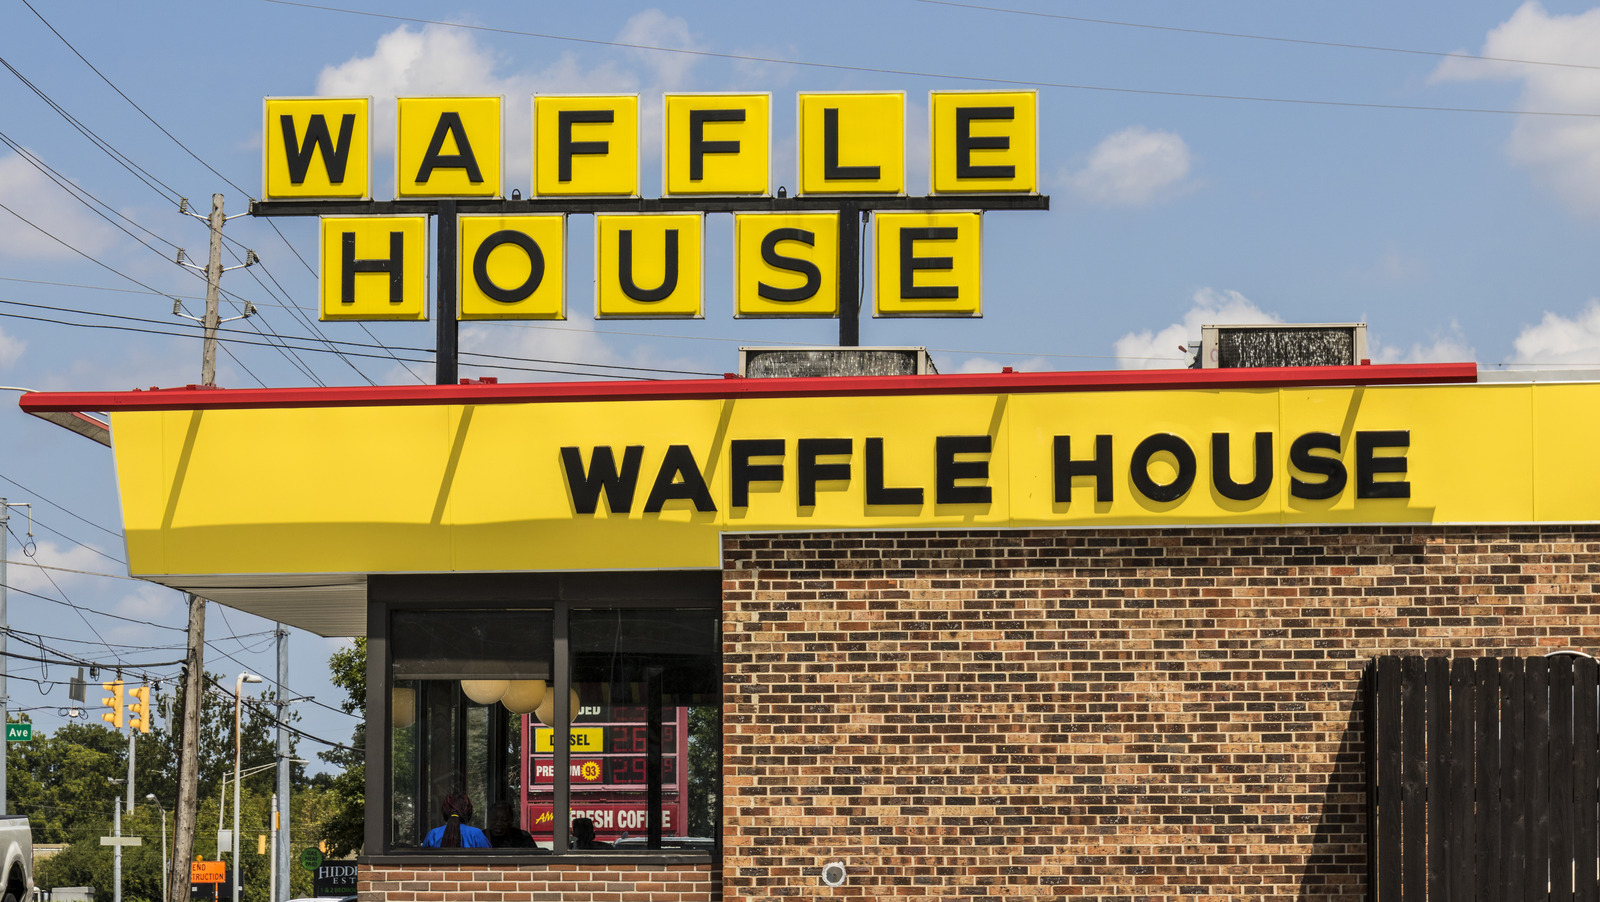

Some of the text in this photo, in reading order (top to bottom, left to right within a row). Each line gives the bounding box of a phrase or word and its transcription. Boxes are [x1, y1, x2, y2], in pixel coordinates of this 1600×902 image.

[281, 107, 1015, 184] WAFFLE
[341, 227, 959, 304] HOUSE
[560, 430, 1411, 515] WAFFLE HOUSE
[9, 727, 29, 737] Ave
[549, 734, 591, 746] DSEL
[536, 765, 581, 777] PREM
[585, 766, 597, 777] 93
[617, 809, 671, 828] COFE
[191, 873, 224, 881] TRUCTION
[318, 866, 358, 880] HIDD
